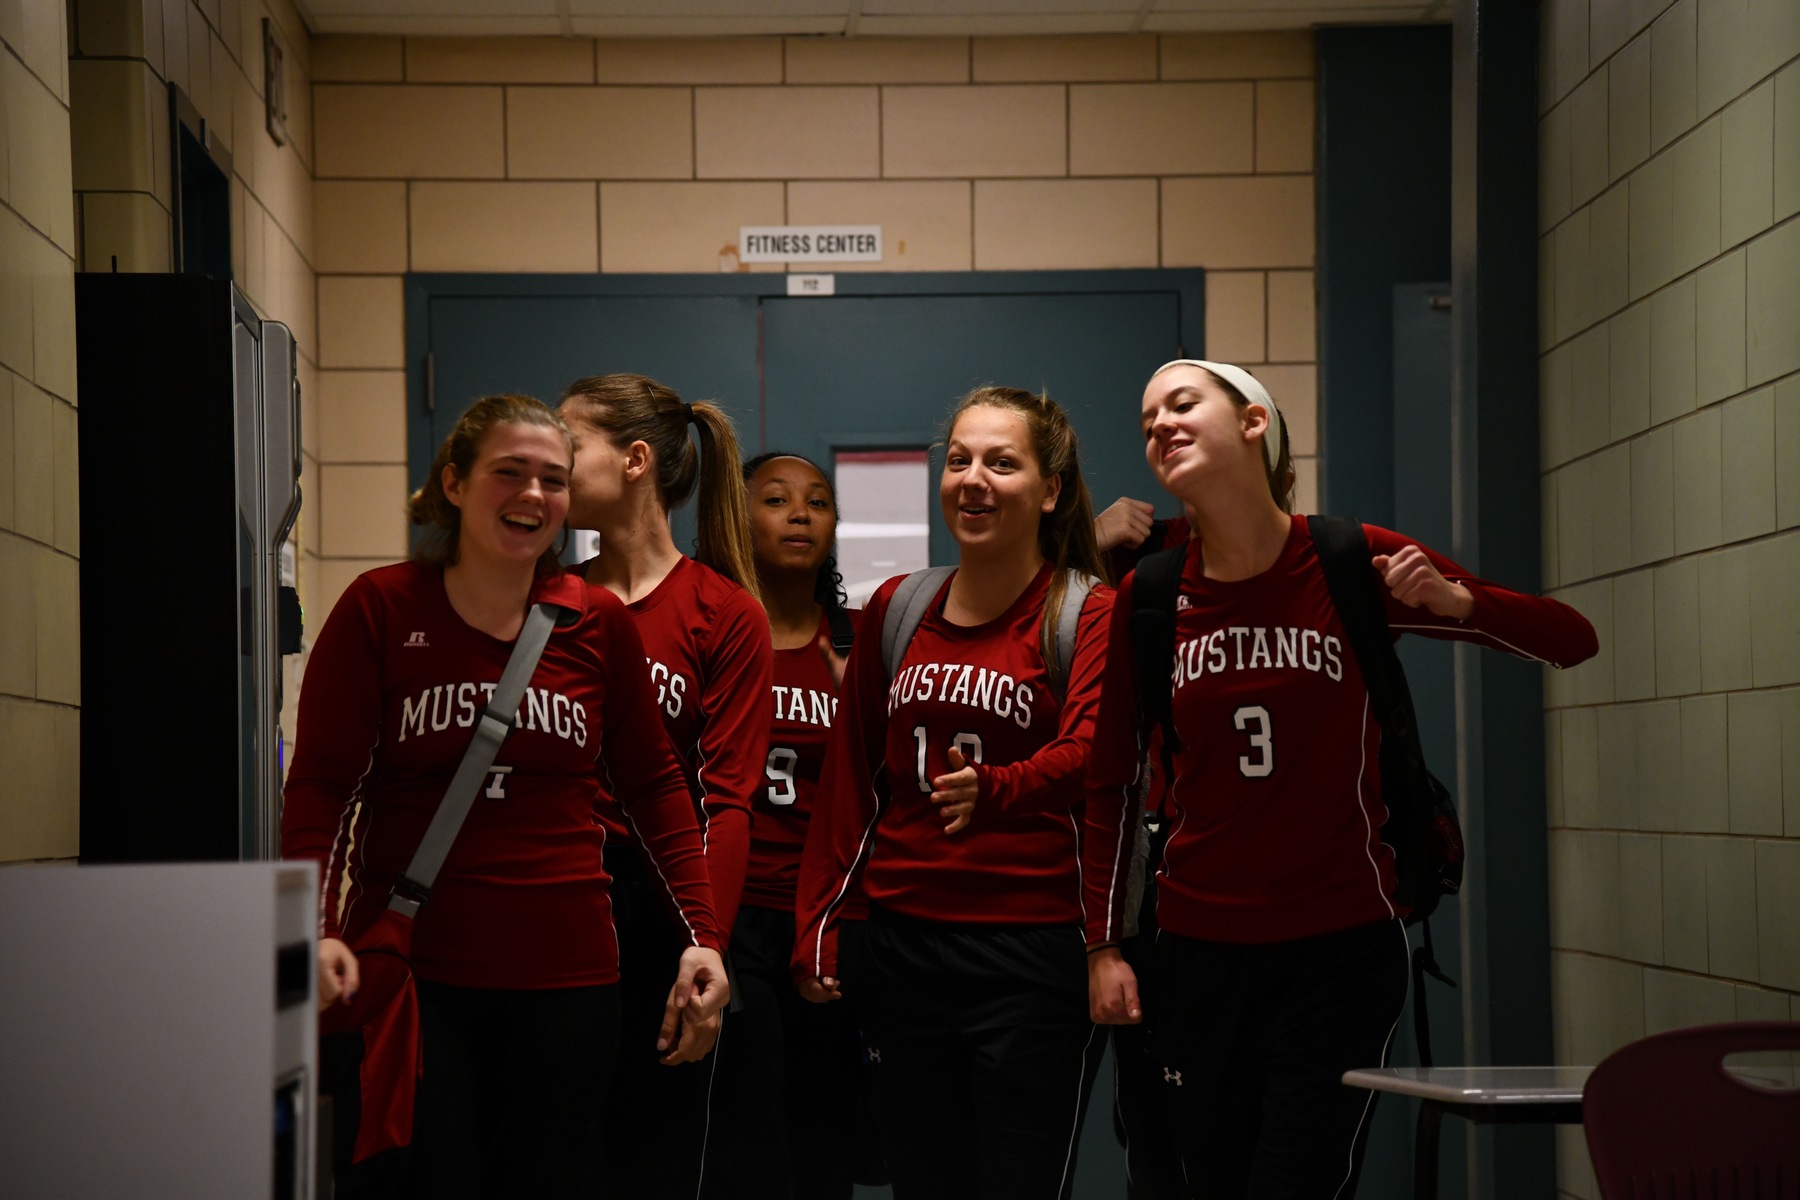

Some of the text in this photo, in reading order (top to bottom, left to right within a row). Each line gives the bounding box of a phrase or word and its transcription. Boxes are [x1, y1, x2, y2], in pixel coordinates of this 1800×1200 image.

[746, 234, 877, 254] FITNESS CENTER
[888, 662, 1034, 731] MUSTANGS
[1171, 626, 1343, 700] MUSTANGS
[398, 682, 588, 749] MUSTNGS
[1233, 705, 1274, 778] 3
[485, 765, 514, 800] 7
[765, 747, 798, 806] 9
